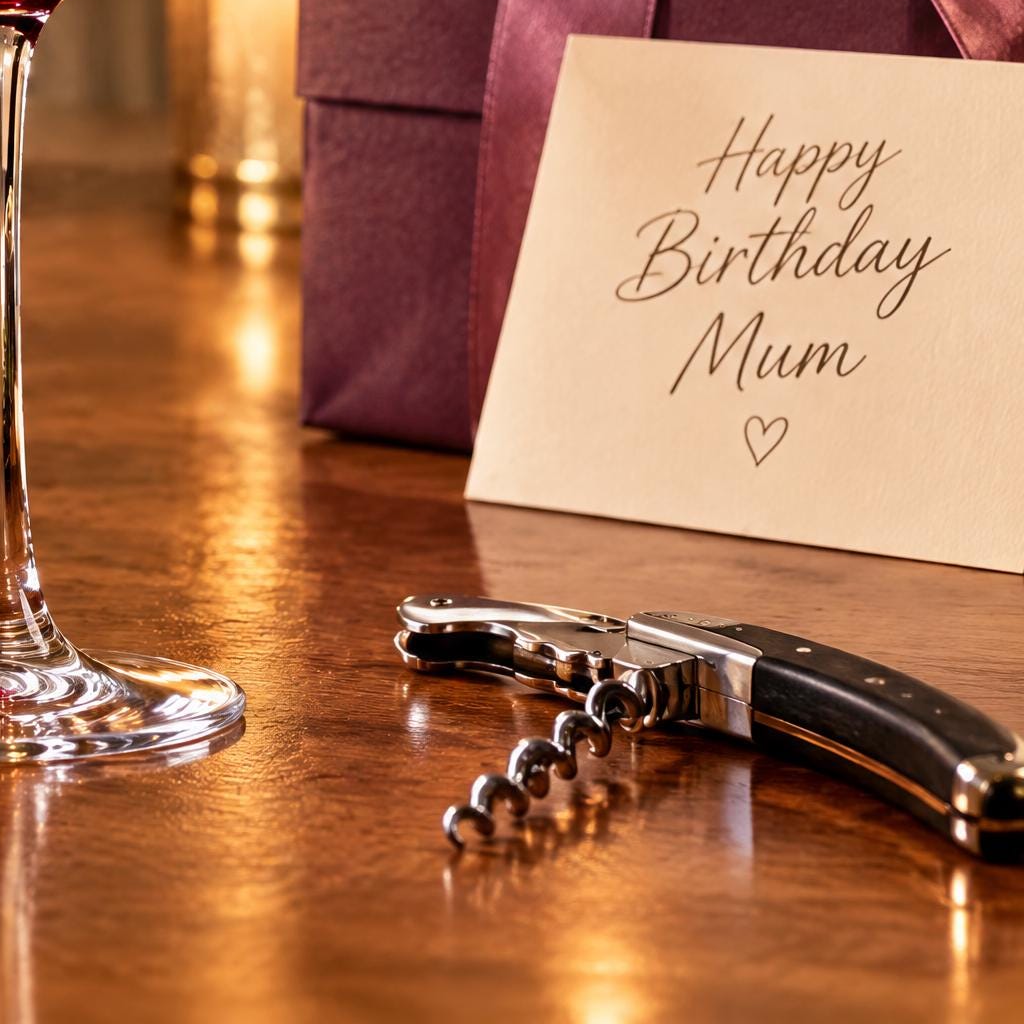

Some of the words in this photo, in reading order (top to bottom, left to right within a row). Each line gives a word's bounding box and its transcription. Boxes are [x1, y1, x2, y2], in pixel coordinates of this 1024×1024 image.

[696, 113, 903, 211] Happy
[614, 203, 952, 320] Birthday
[669, 310, 868, 396] Mum
